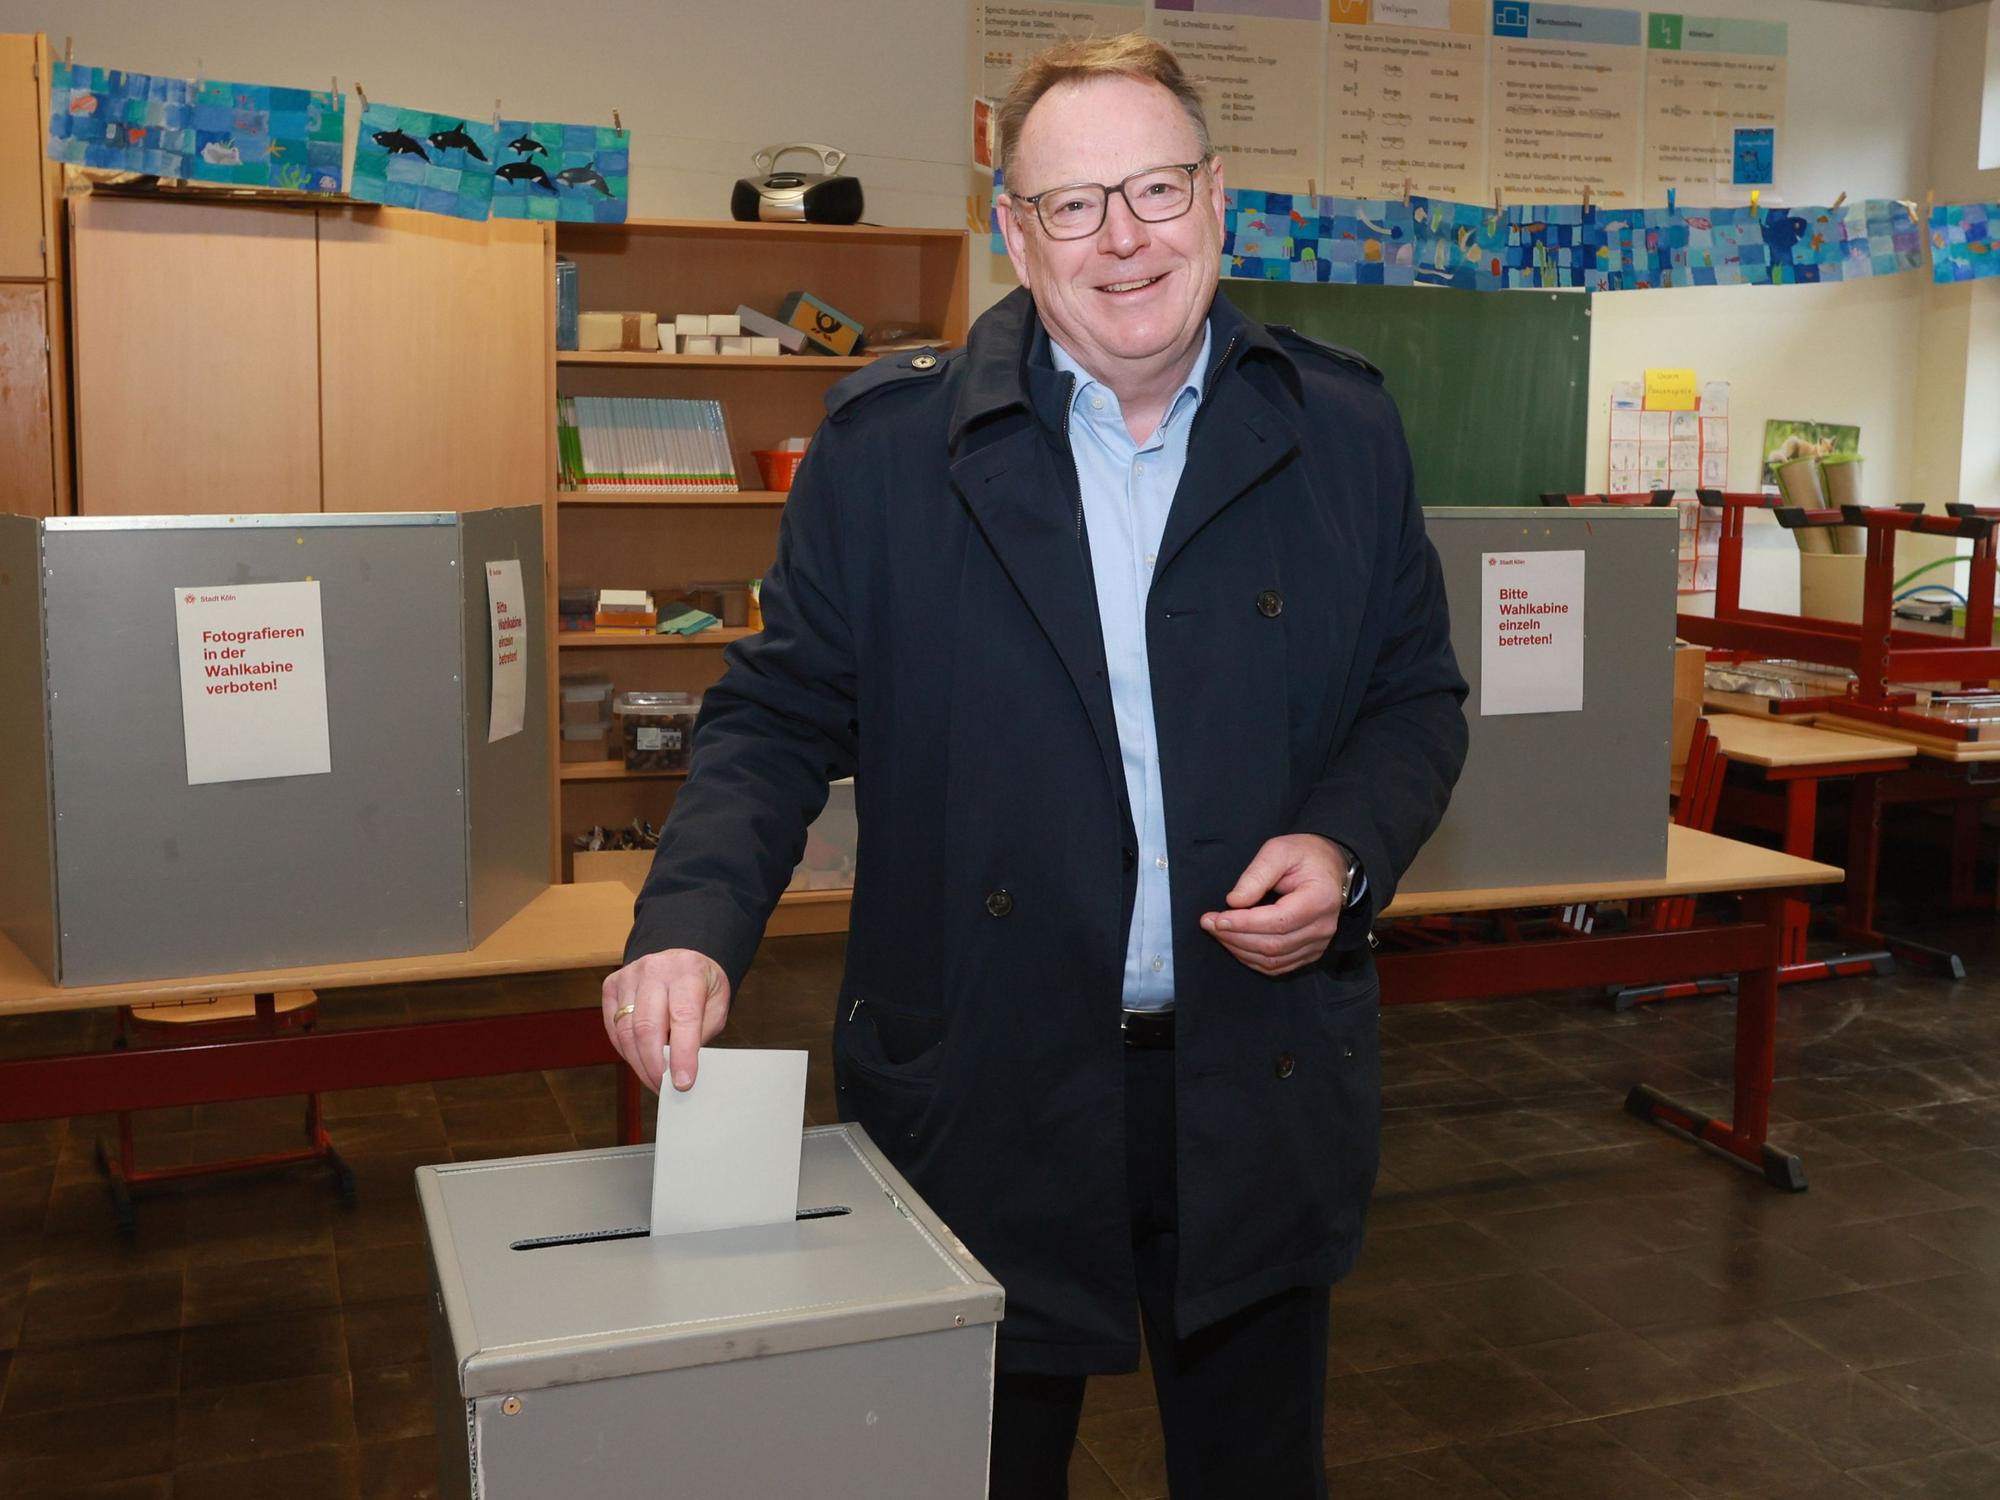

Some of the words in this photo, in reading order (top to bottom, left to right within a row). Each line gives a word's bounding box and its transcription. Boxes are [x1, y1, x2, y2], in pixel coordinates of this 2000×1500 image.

[200, 595, 219, 603] Stadt
[220, 593, 236, 602] Köln
[1500, 589, 1529, 600] Bitte
[1500, 602, 1569, 615] Wahlkabine
[1499, 619, 1541, 631] einzeln
[202, 626, 305, 645] Fotografieren
[1499, 634, 1552, 646] betreten!
[204, 648, 217, 660] in
[220, 646, 246, 660] der
[205, 661, 294, 678] Wahlkabine
[206, 678, 278, 695] verboten!
